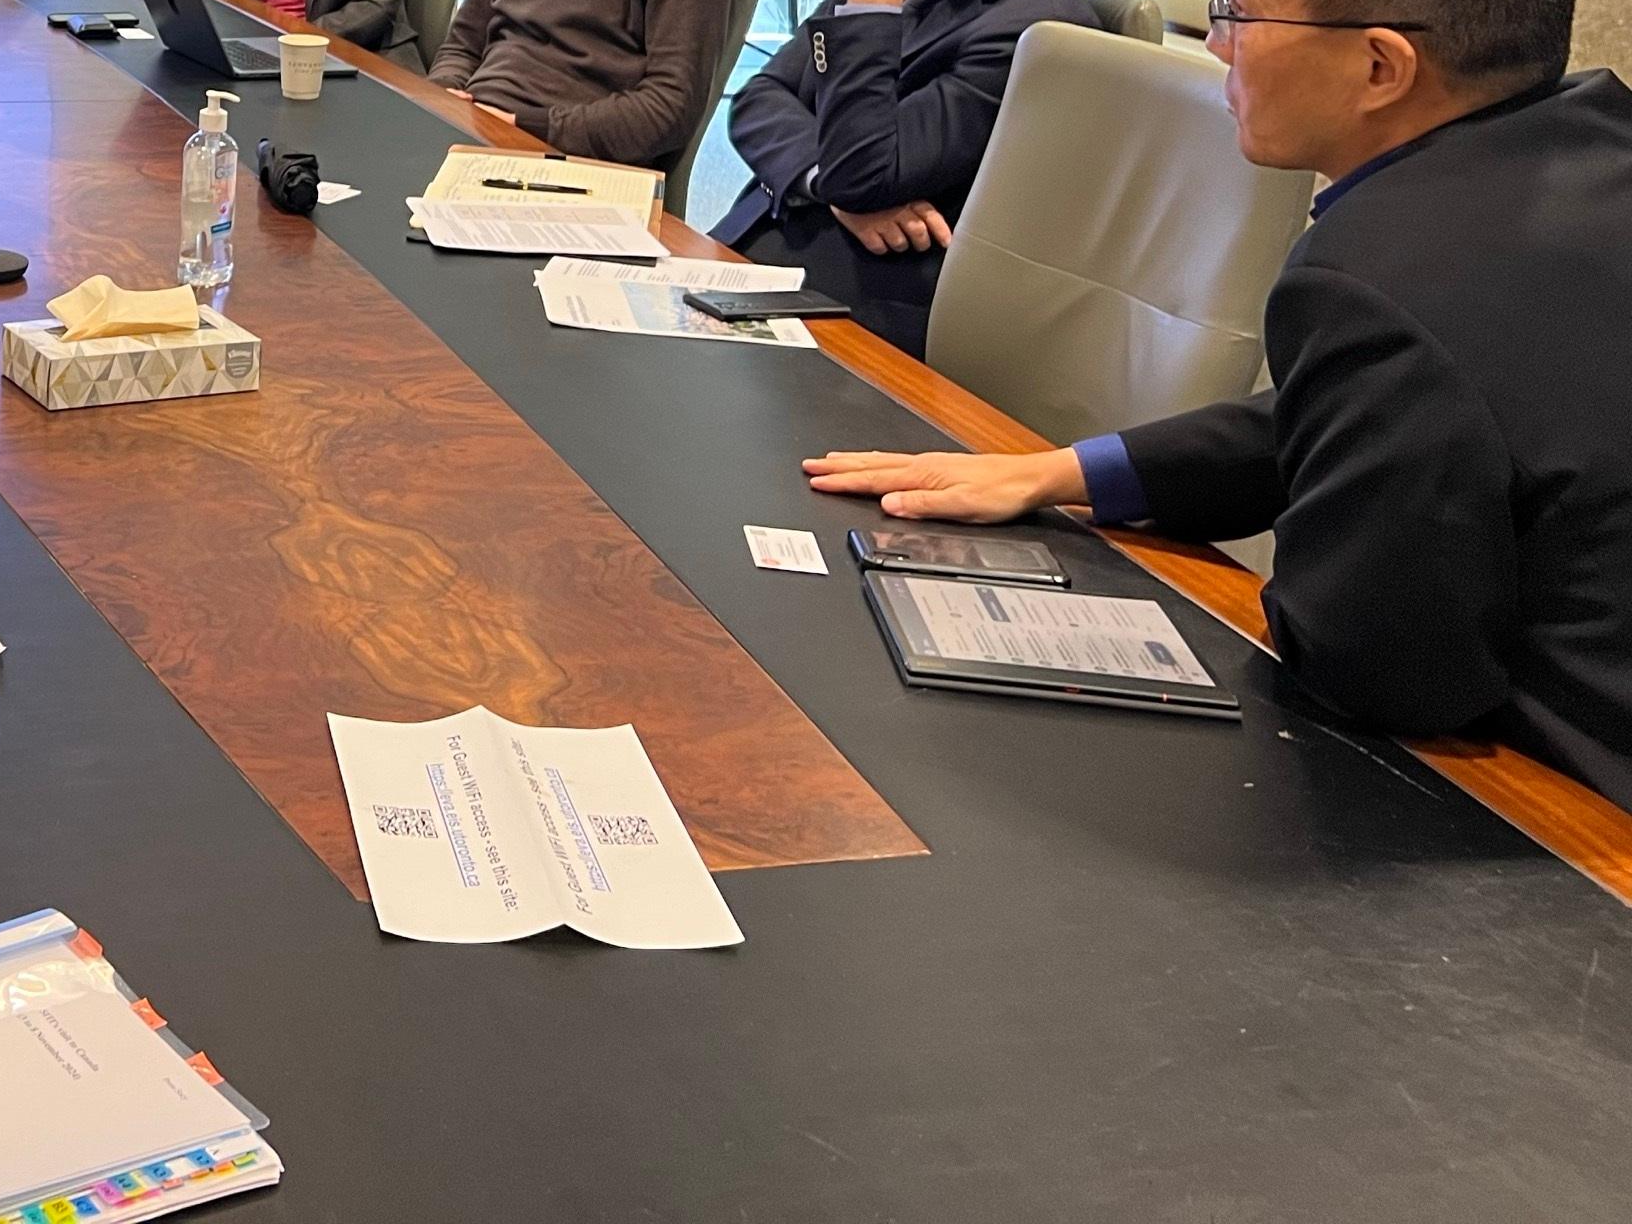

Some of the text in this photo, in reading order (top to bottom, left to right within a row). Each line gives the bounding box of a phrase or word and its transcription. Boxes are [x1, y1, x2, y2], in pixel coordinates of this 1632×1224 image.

[447, 734, 462, 752] For
[453, 752, 471, 781] Guest
[463, 779, 483, 803] WiFi
[470, 804, 492, 839] access
[537, 800, 560, 837] access
[485, 845, 501, 865] see
[492, 864, 512, 887] this
[560, 861, 583, 894] Guest
[500, 886, 519, 912] site:
[576, 893, 593, 915] For
